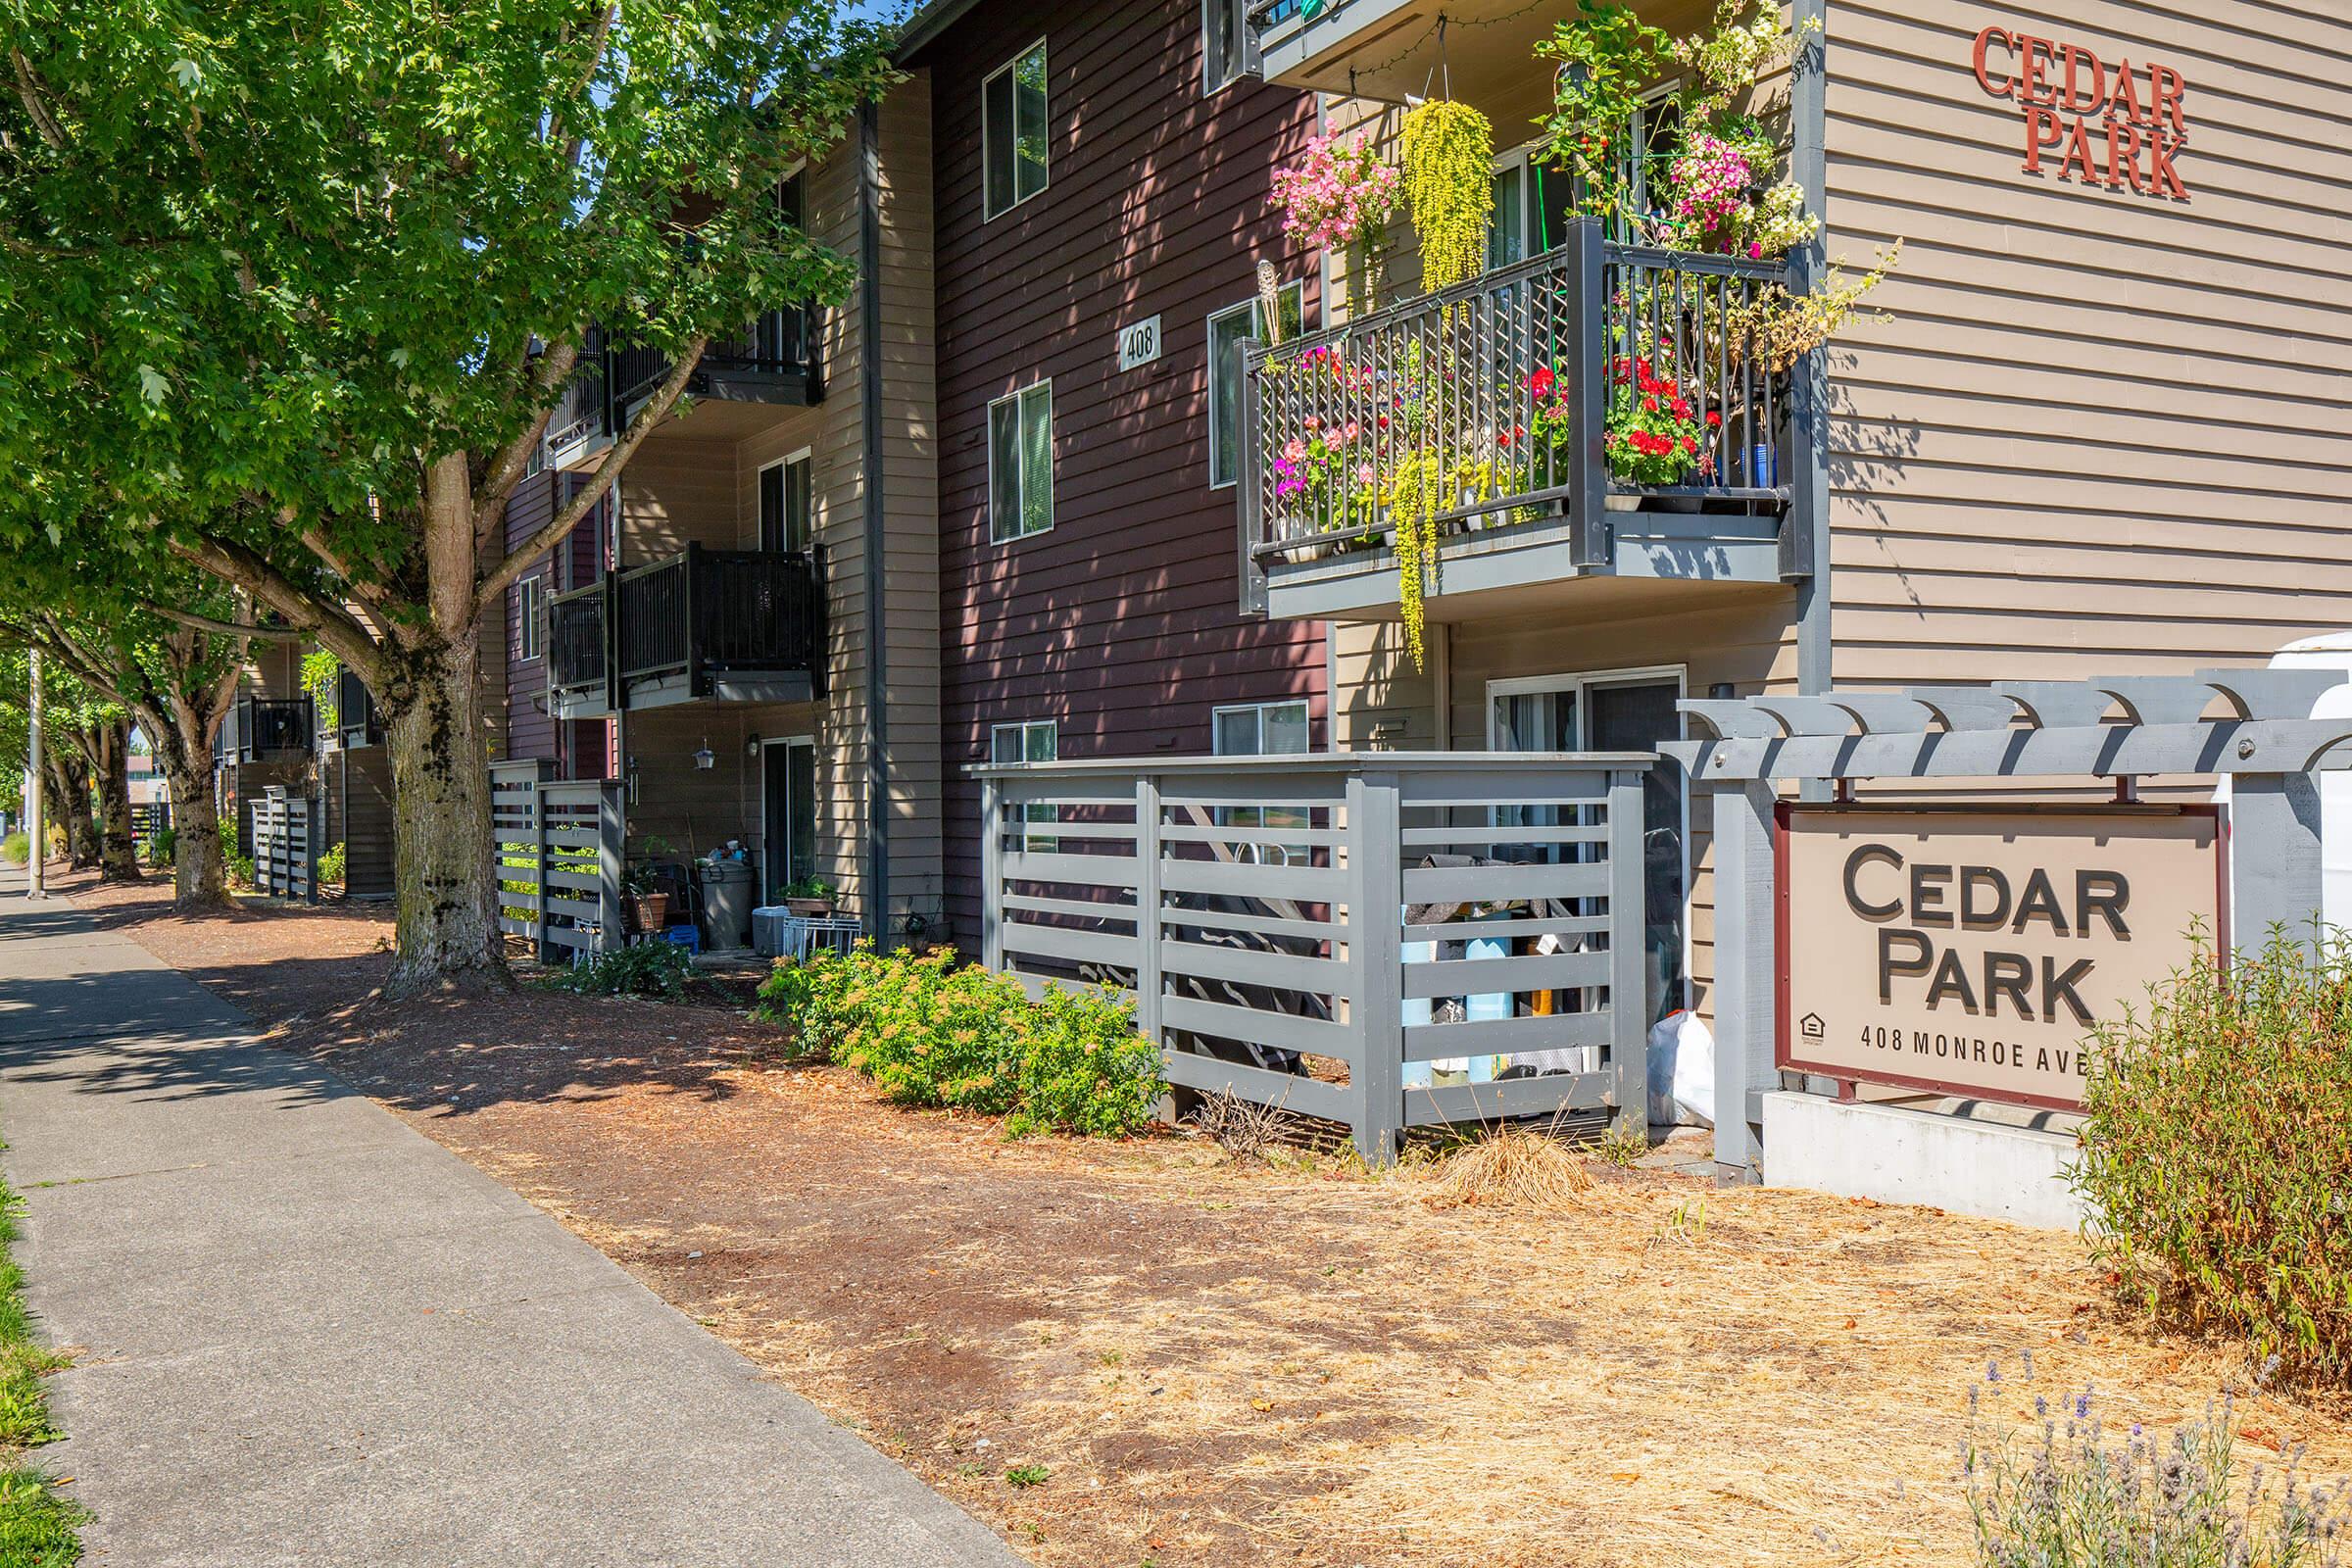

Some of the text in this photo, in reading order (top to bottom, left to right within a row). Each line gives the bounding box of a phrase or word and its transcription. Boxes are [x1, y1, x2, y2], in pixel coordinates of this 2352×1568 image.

[1973, 25, 2188, 133] CEDAR
[2021, 105, 2190, 199] PARK
[1127, 325, 1153, 361] 408
[1843, 843, 2132, 941] CEDAR
[1878, 927, 2096, 1027] PARK
[1861, 1024, 1902, 1052] 408
[1913, 1031, 2024, 1068] MONROE
[2035, 1047, 2089, 1077] AVE
